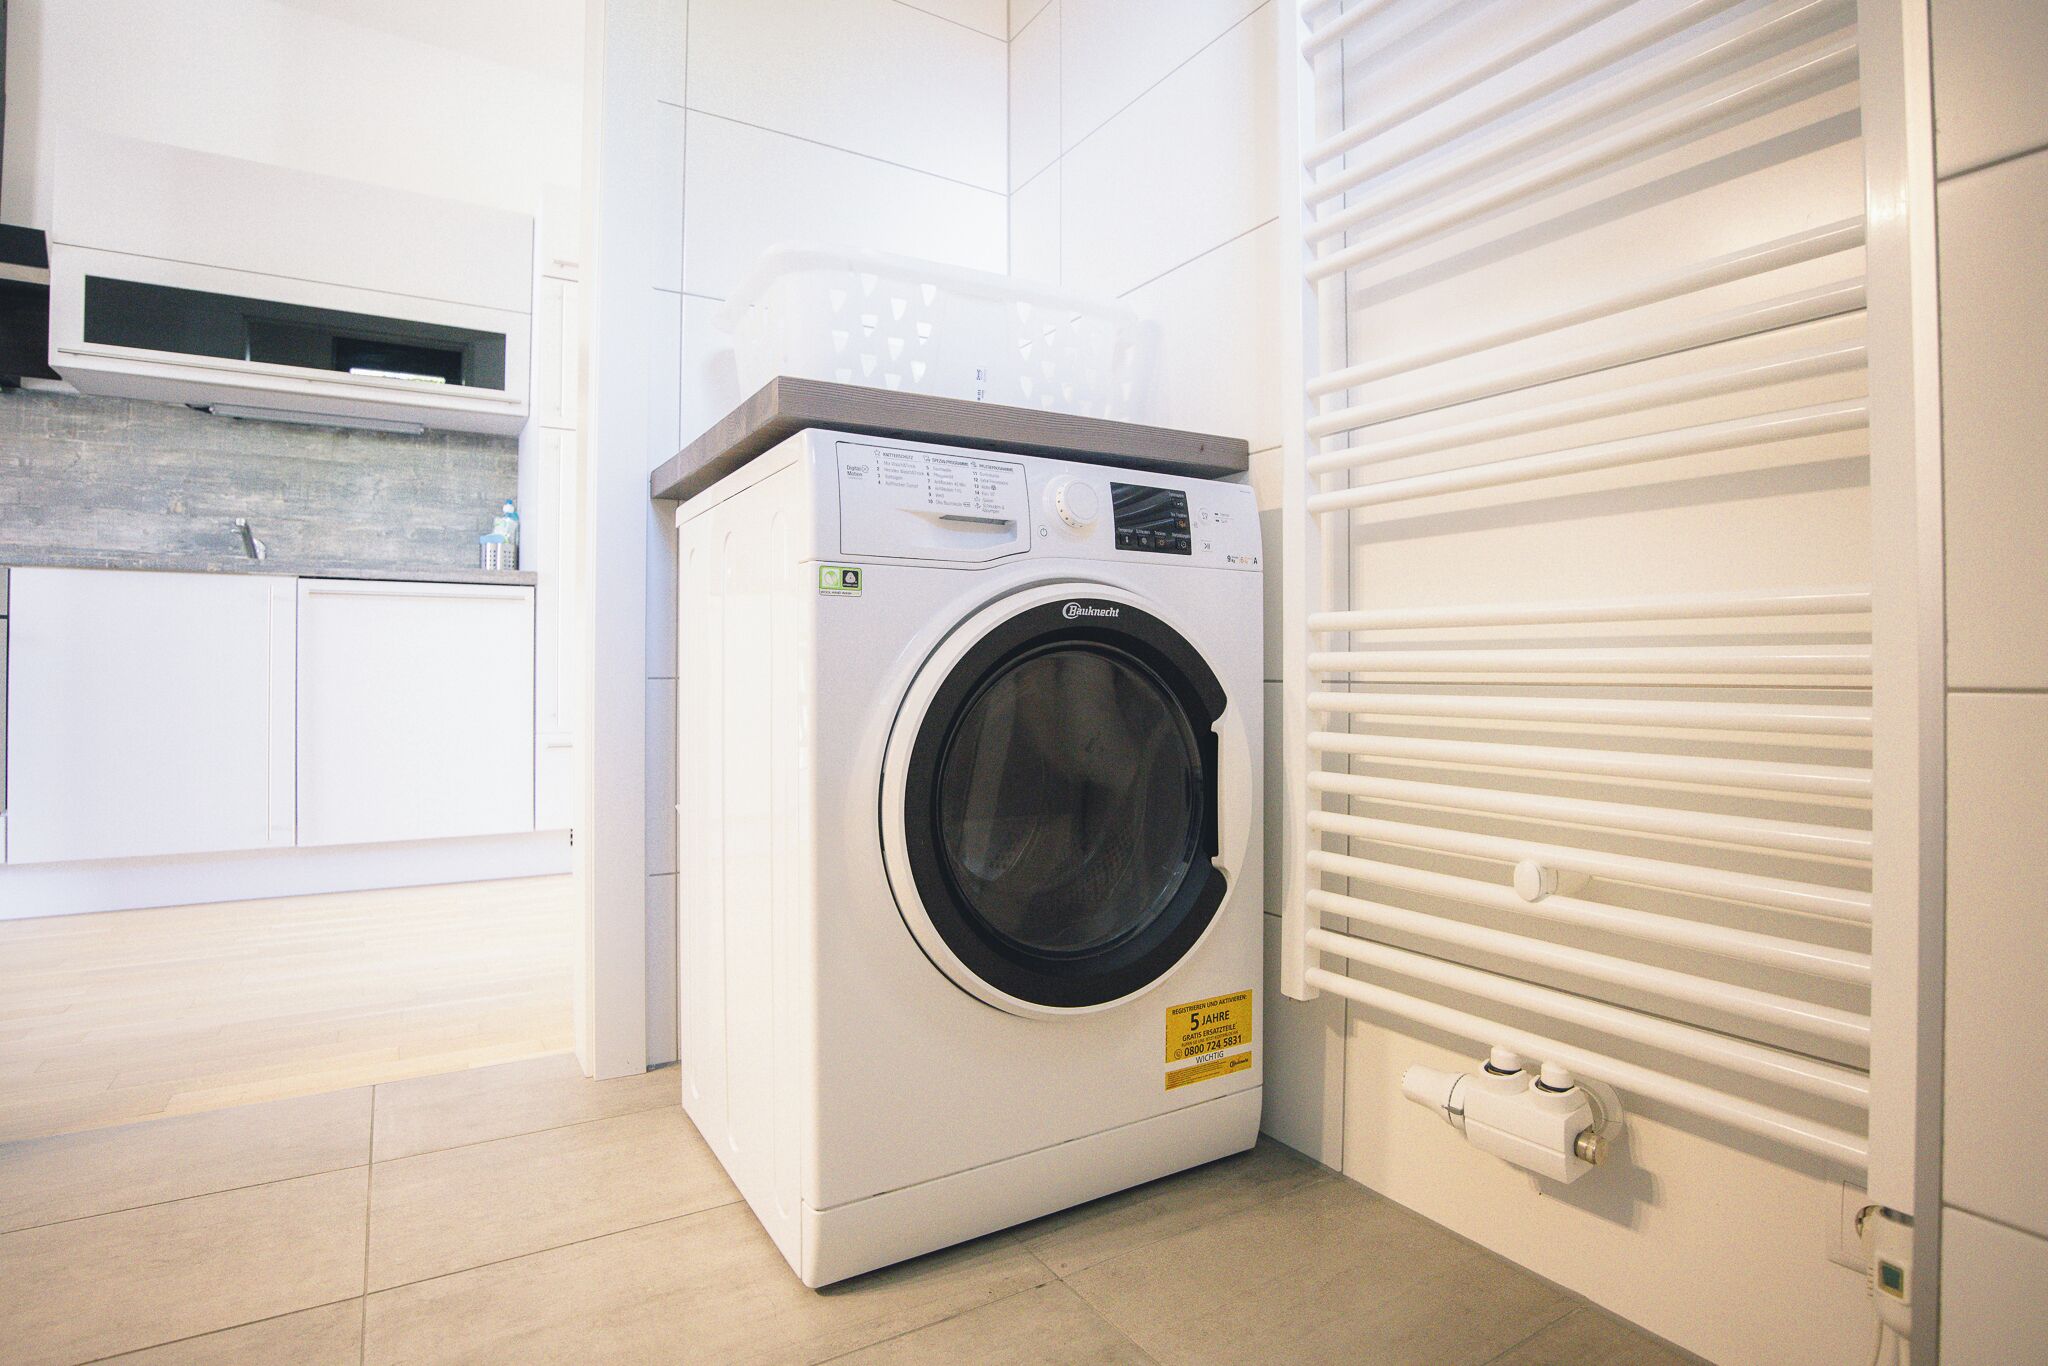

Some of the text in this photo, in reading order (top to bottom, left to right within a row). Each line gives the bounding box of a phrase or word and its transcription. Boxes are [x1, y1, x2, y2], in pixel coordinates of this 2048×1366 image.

[1062, 602, 1120, 619] Bauknecht
[1172, 1002, 1206, 1015] REGISTRIEREN
[1190, 1010, 1230, 1031] 5 JAHRE
[1182, 1031, 1202, 1042] GRATIS
[1184, 1034, 1242, 1057] 0800 724 5831
[1195, 1050, 1224, 1064] WICHTIG
